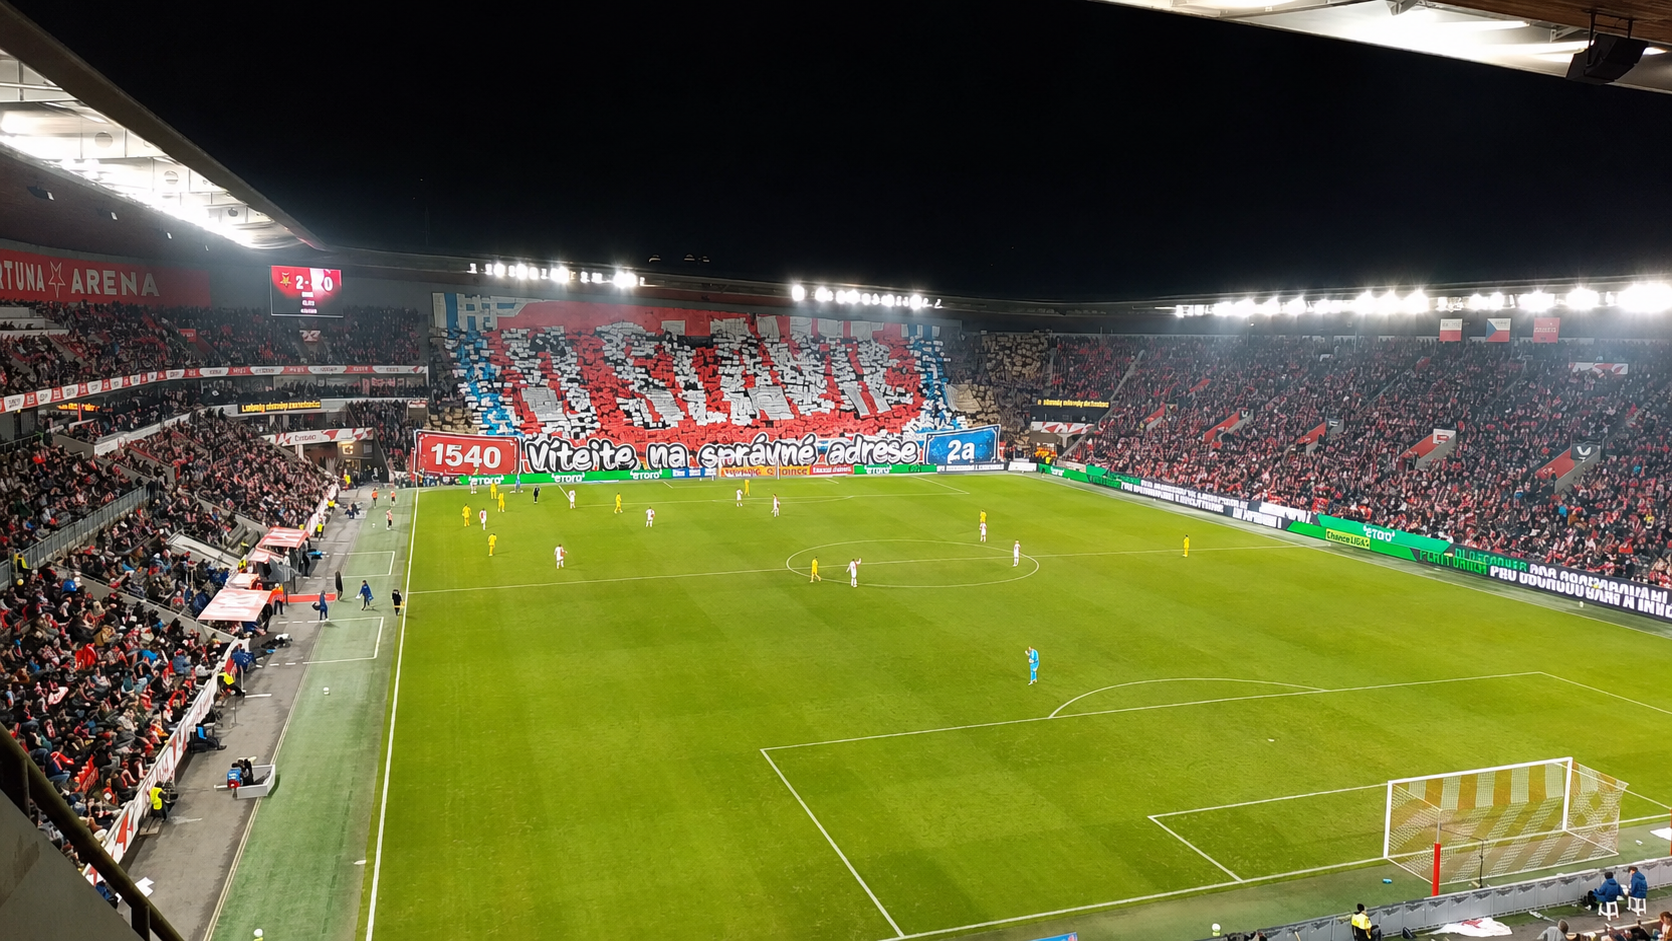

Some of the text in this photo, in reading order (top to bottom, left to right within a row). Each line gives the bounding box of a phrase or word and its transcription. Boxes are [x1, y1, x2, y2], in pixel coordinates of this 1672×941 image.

[71, 268, 160, 297] ARENA
[295, 275, 304, 290] 2
[323, 276, 334, 292] 0
[430, 443, 502, 468] 1540
[649, 445, 688, 470] na
[700, 434, 817, 467] správné
[828, 435, 919, 464] adrese
[947, 439, 976, 464] 2a
[1326, 530, 1351, 543] Chance
